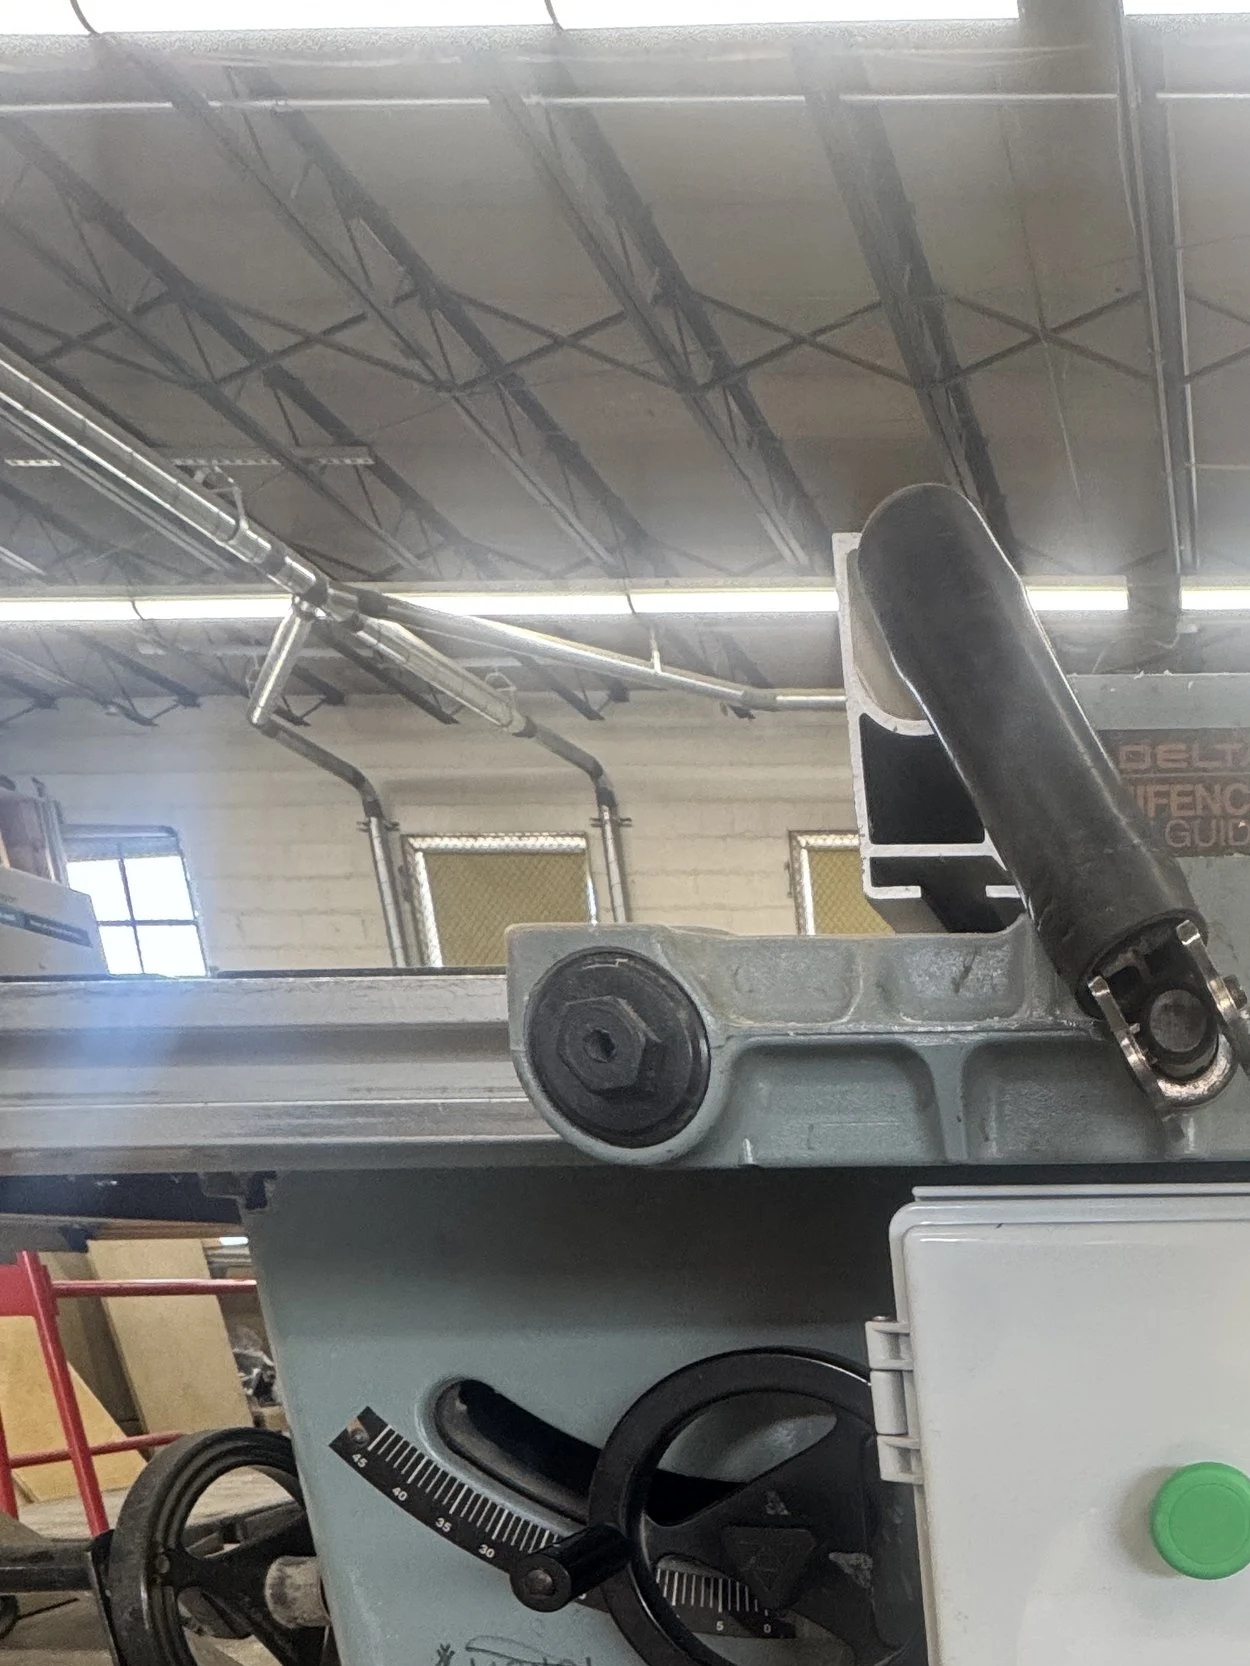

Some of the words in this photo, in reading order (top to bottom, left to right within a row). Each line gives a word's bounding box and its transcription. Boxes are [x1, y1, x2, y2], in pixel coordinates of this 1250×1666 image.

[352, 1452, 368, 1468] 45
[391, 1486, 408, 1502] 40
[435, 1516, 452, 1534] 35
[478, 1543, 495, 1559] 30
[715, 1620, 724, 1631] 5
[763, 1623, 772, 1634] 0
